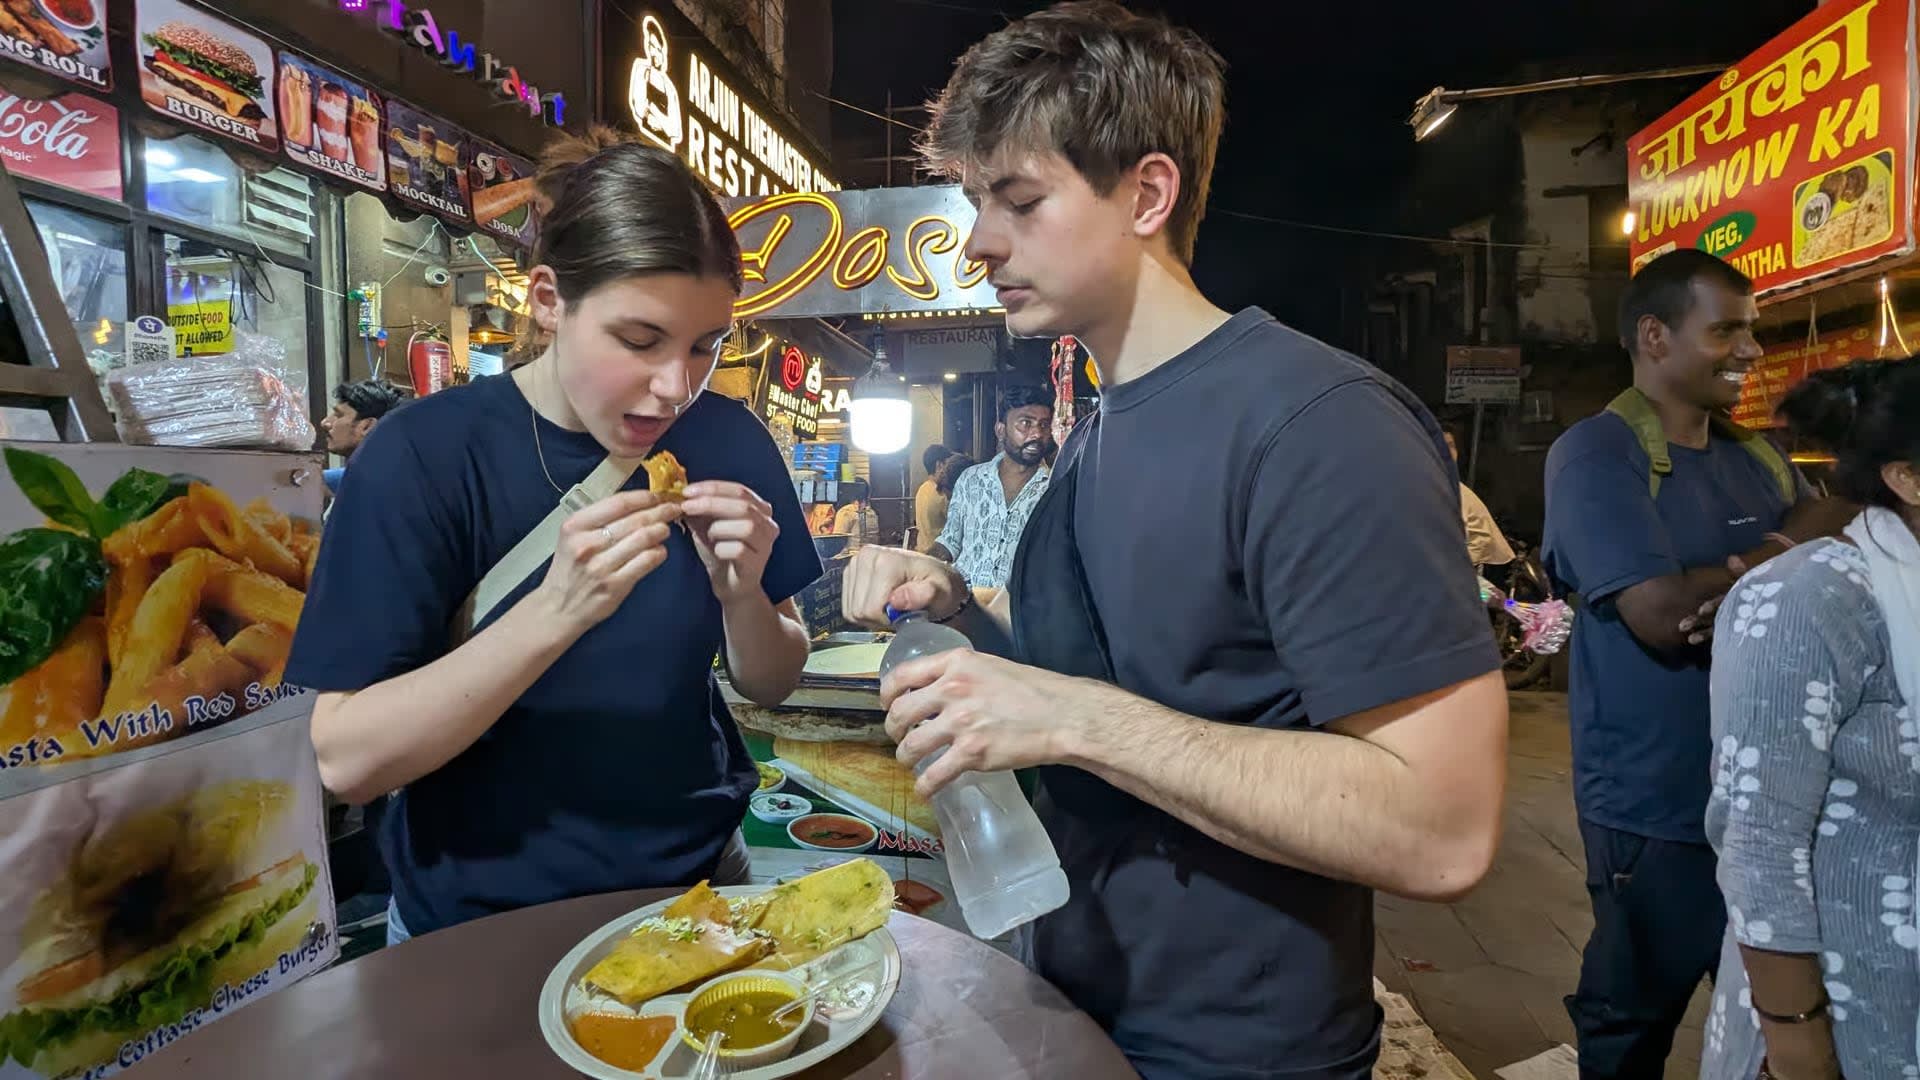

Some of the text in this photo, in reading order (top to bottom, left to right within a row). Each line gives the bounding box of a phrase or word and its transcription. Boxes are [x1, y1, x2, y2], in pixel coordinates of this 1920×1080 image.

[40, 48, 106, 86] ROLL
[688, 52, 739, 141] ARJUN
[166, 95, 261, 143] BURGER
[308, 150, 369, 183] SHAKE
[688, 115, 787, 197] RESTA
[1638, 84, 1880, 243] LUCKNOW KA
[397, 183, 467, 218] MOCKTAIL
[492, 218, 521, 239] DOSA
[1704, 221, 1743, 253] VEG.
[202, 311, 224, 324] FOOD
[185, 331, 224, 345] ALLOWED
[766, 402, 816, 434] STET FOOD
[773, 385, 799, 411] Master
[800, 397, 819, 419] Chef
[80, 701, 173, 748] With
[183, 691, 236, 725] Red
[119, 1009, 204, 1068] Cottage
[212, 970, 270, 1013] Cheese
[278, 932, 331, 975] Burger
